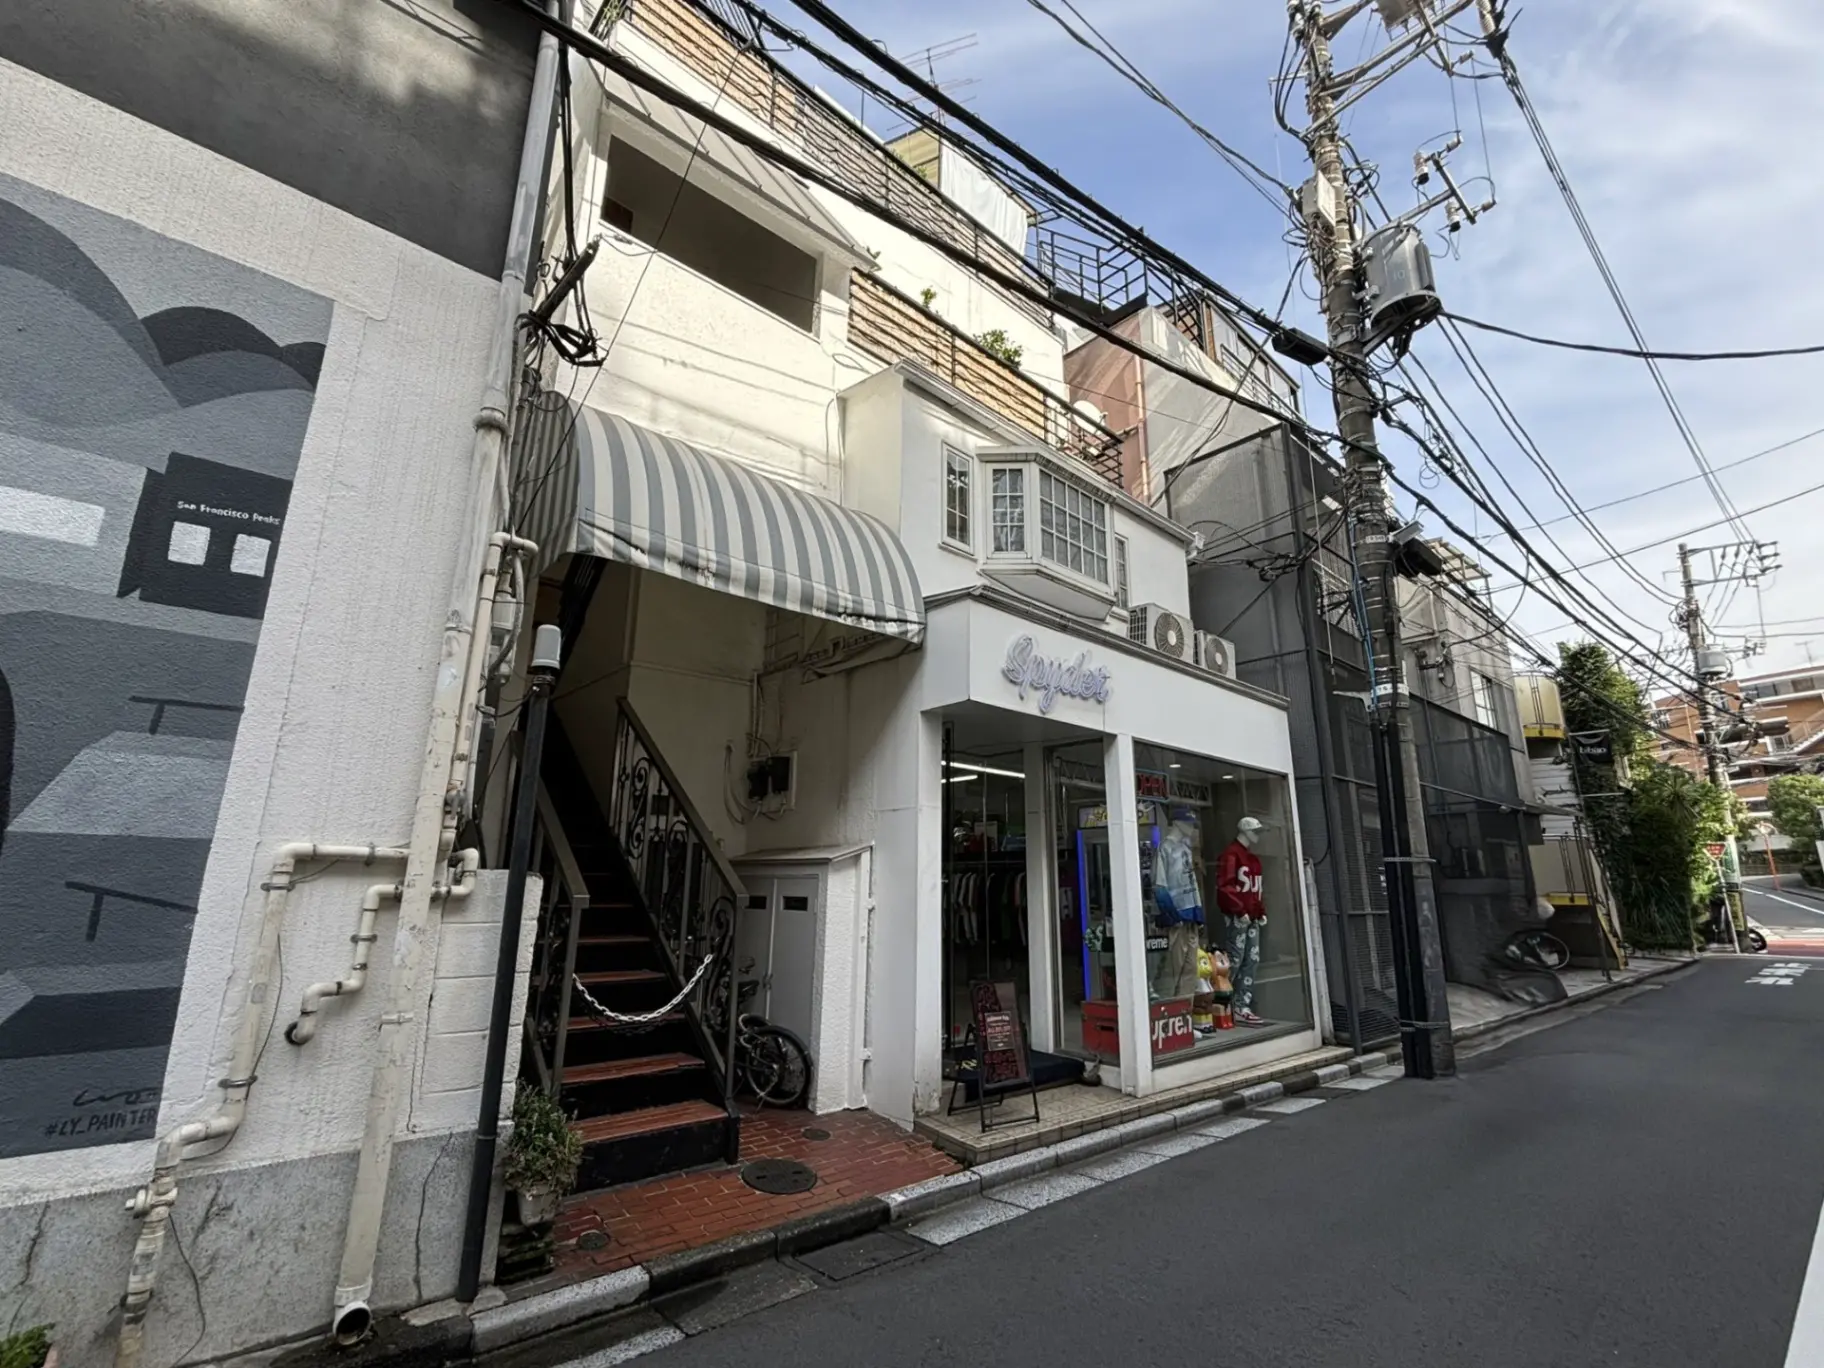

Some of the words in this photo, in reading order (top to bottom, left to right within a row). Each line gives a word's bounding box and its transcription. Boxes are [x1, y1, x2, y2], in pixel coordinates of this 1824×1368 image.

[177, 500, 197, 511] San
[200, 504, 249, 520] Francisco
[252, 513, 281, 525] Peaks
[1001, 633, 1112, 715] Spyder
[44, 1107, 159, 1139] #LY_PAINTER
